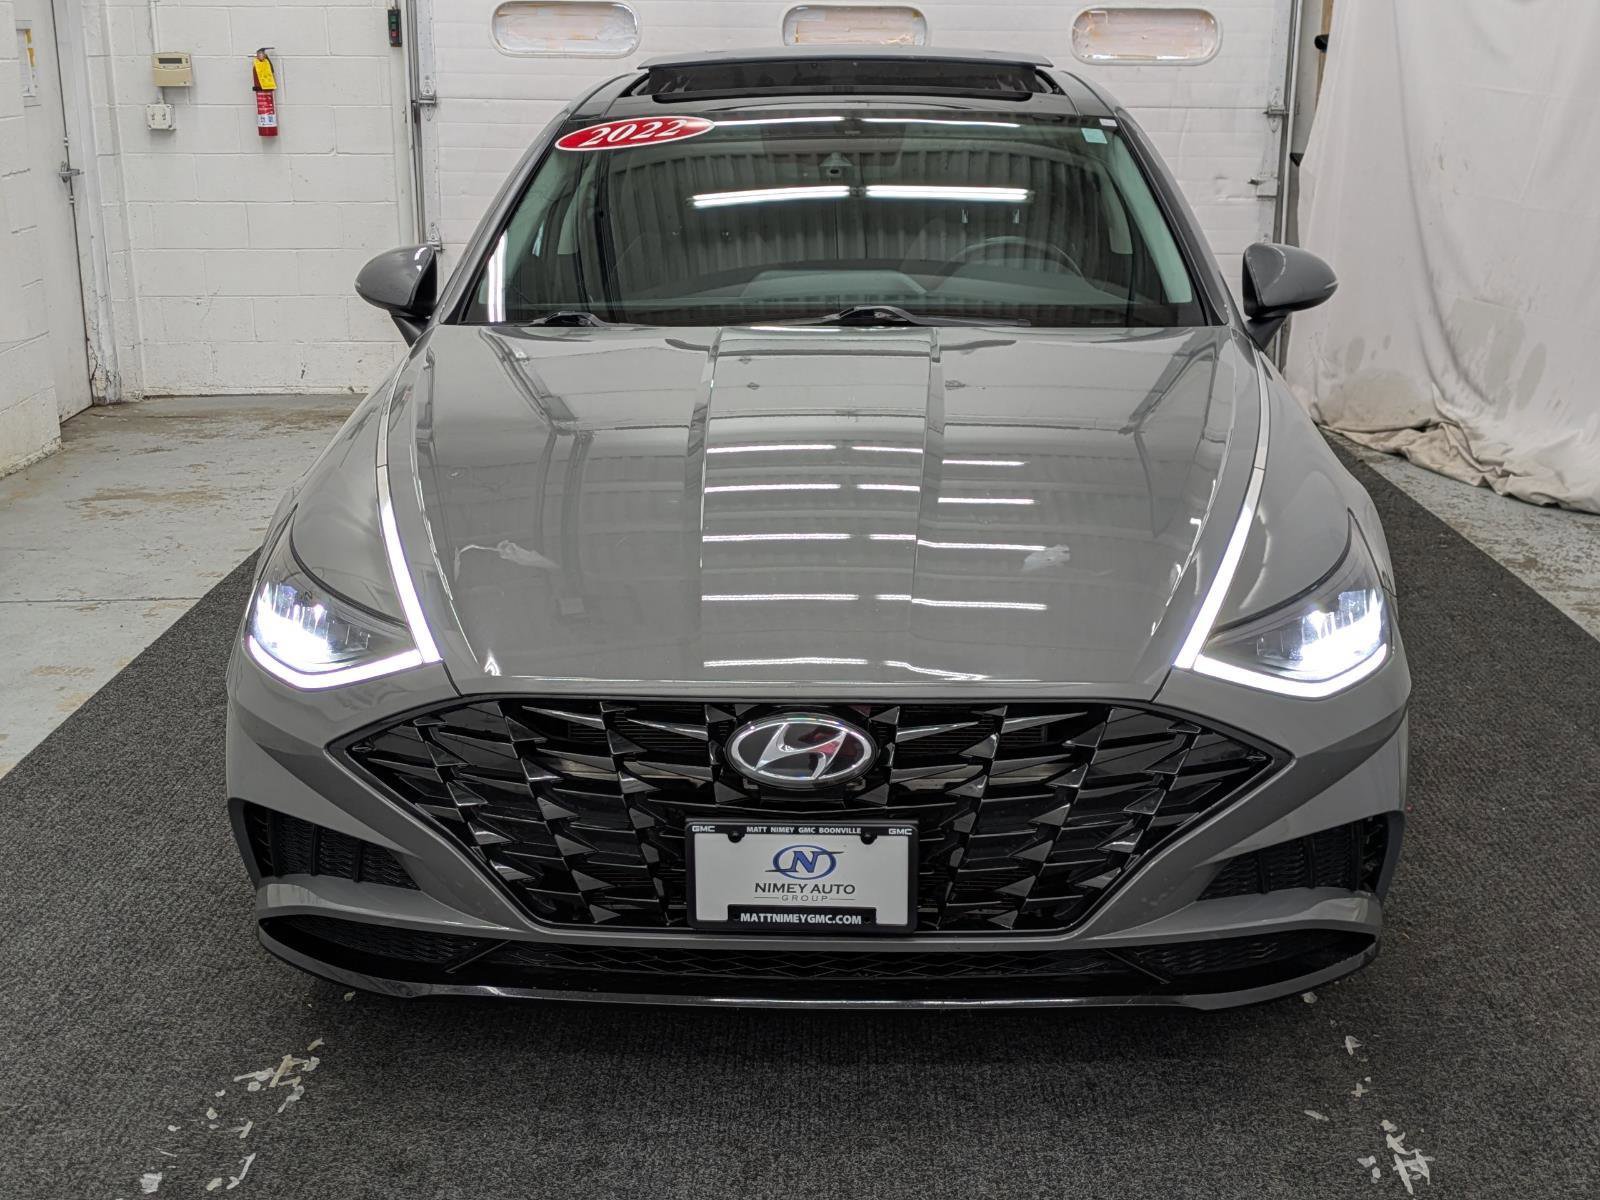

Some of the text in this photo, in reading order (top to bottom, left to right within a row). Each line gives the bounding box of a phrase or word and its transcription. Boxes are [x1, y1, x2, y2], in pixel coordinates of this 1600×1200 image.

[578, 119, 688, 147] 2022
[754, 882, 856, 895] NIMEY AUTO
[740, 912, 862, 925] MATTNIMEYGMC.COM
